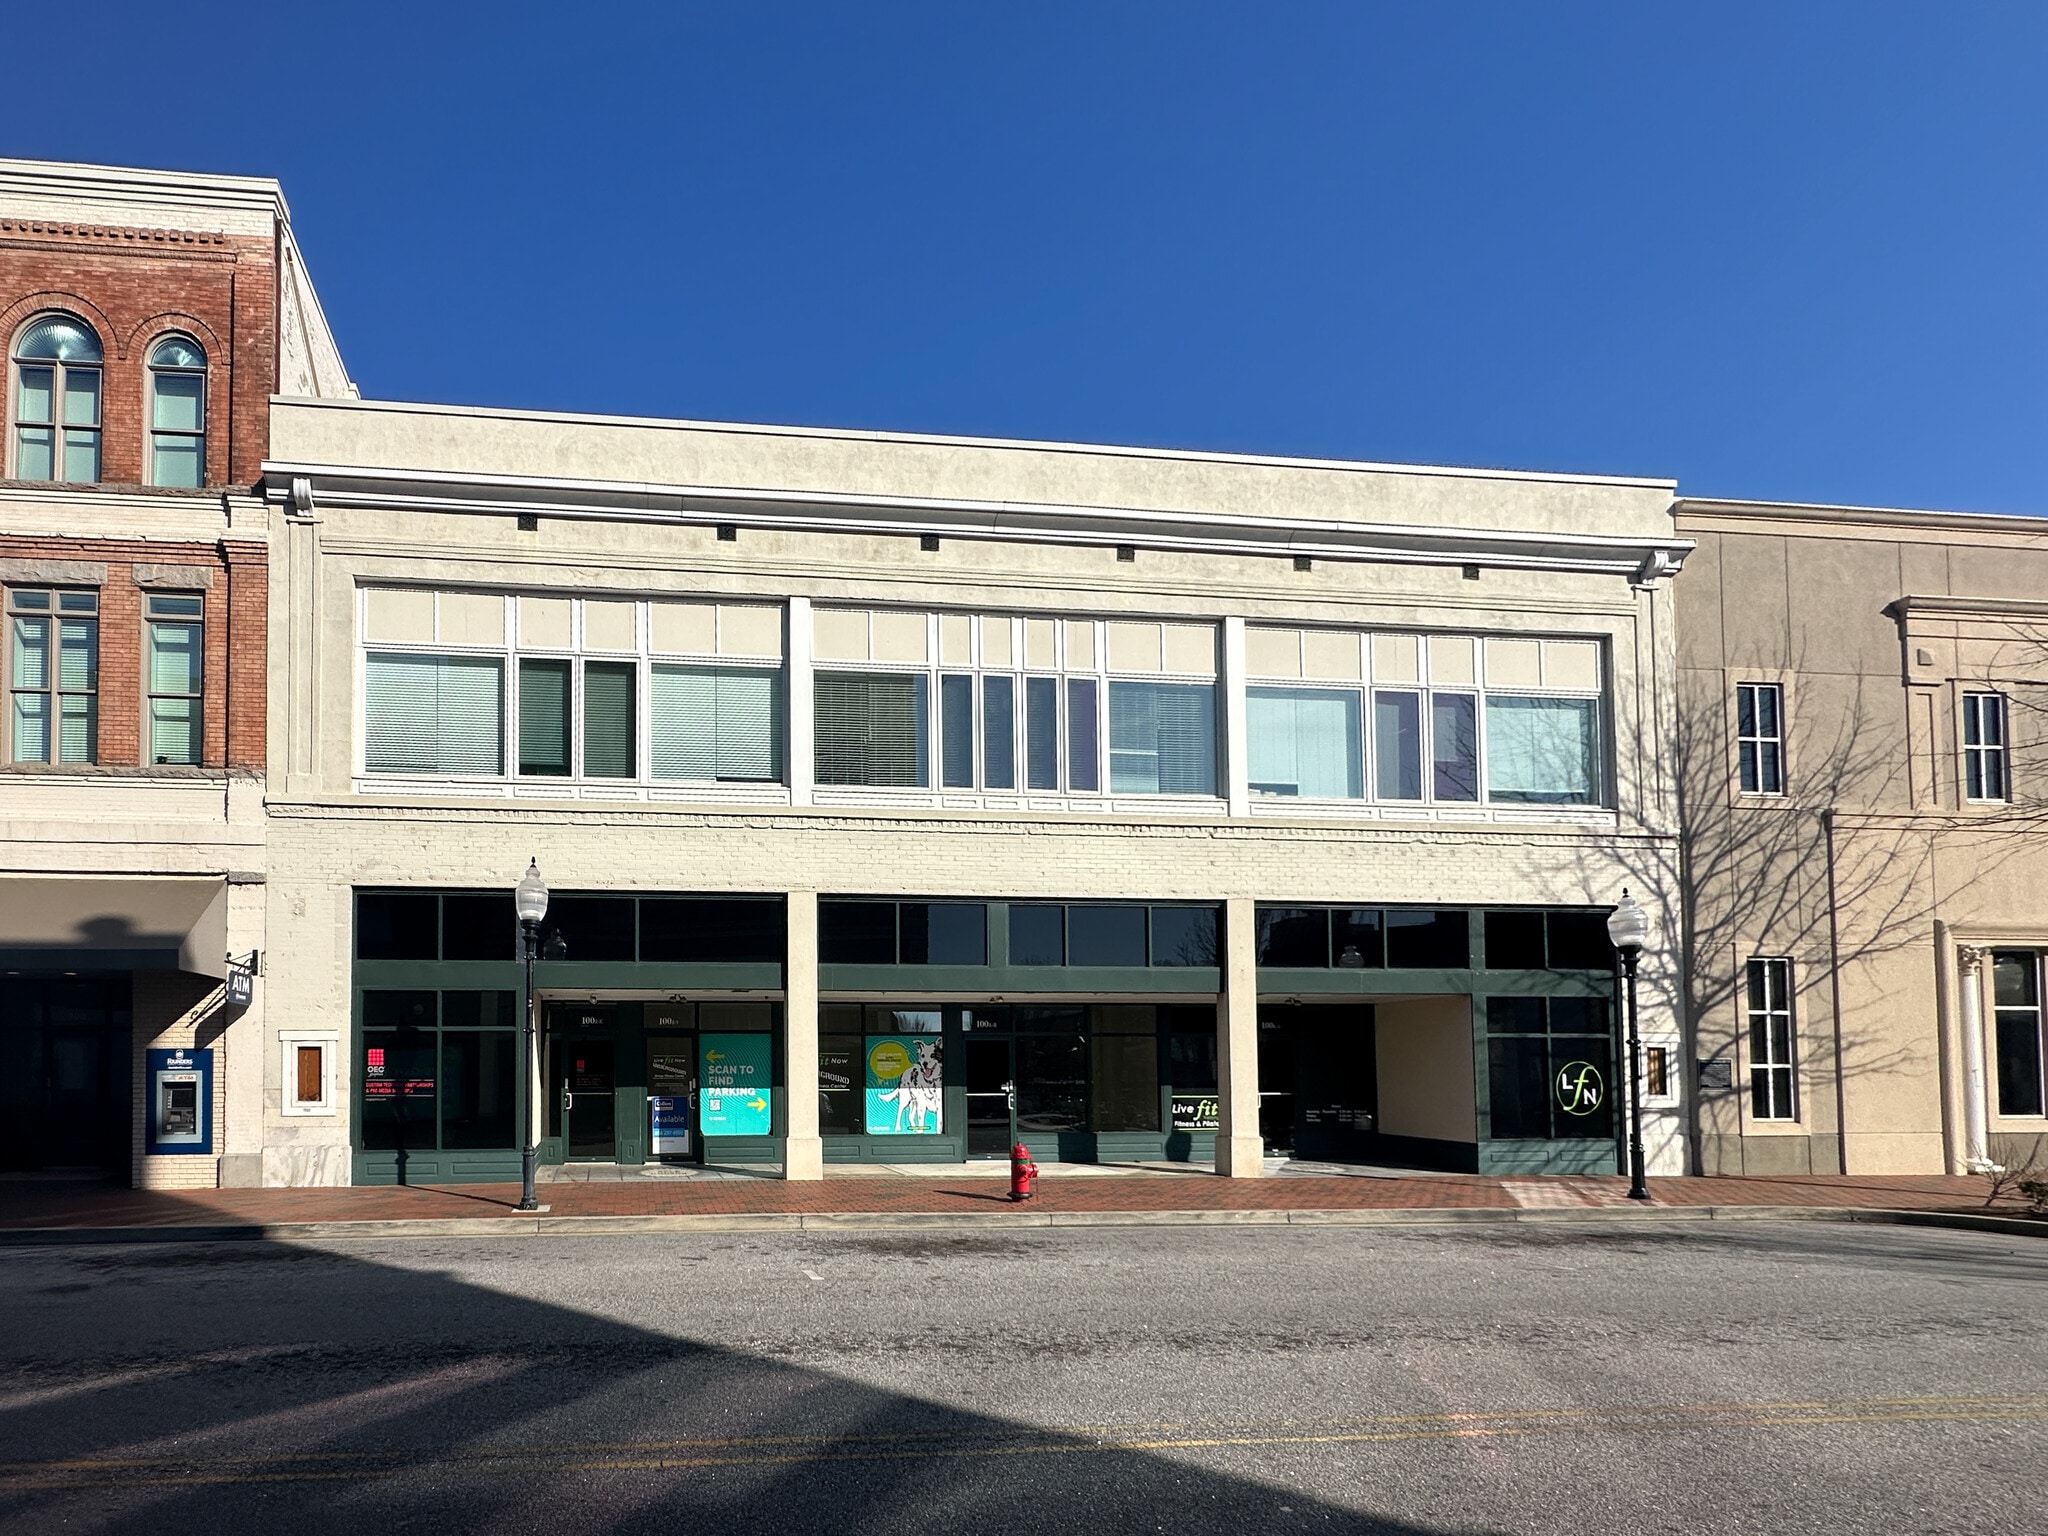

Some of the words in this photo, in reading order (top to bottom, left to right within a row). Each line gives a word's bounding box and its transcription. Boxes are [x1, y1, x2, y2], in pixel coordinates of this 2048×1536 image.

[232, 975, 250, 993] ATM
[708, 1065, 732, 1074] SCAN
[734, 1065, 755, 1074] TO
[708, 1076, 734, 1085] FIND
[819, 1070, 850, 1084] GROUND
[708, 1087, 756, 1096] PARKING
[1172, 1104, 1195, 1114] Live
[1193, 1099, 1219, 1121] fit
[654, 1115, 685, 1123] Available
